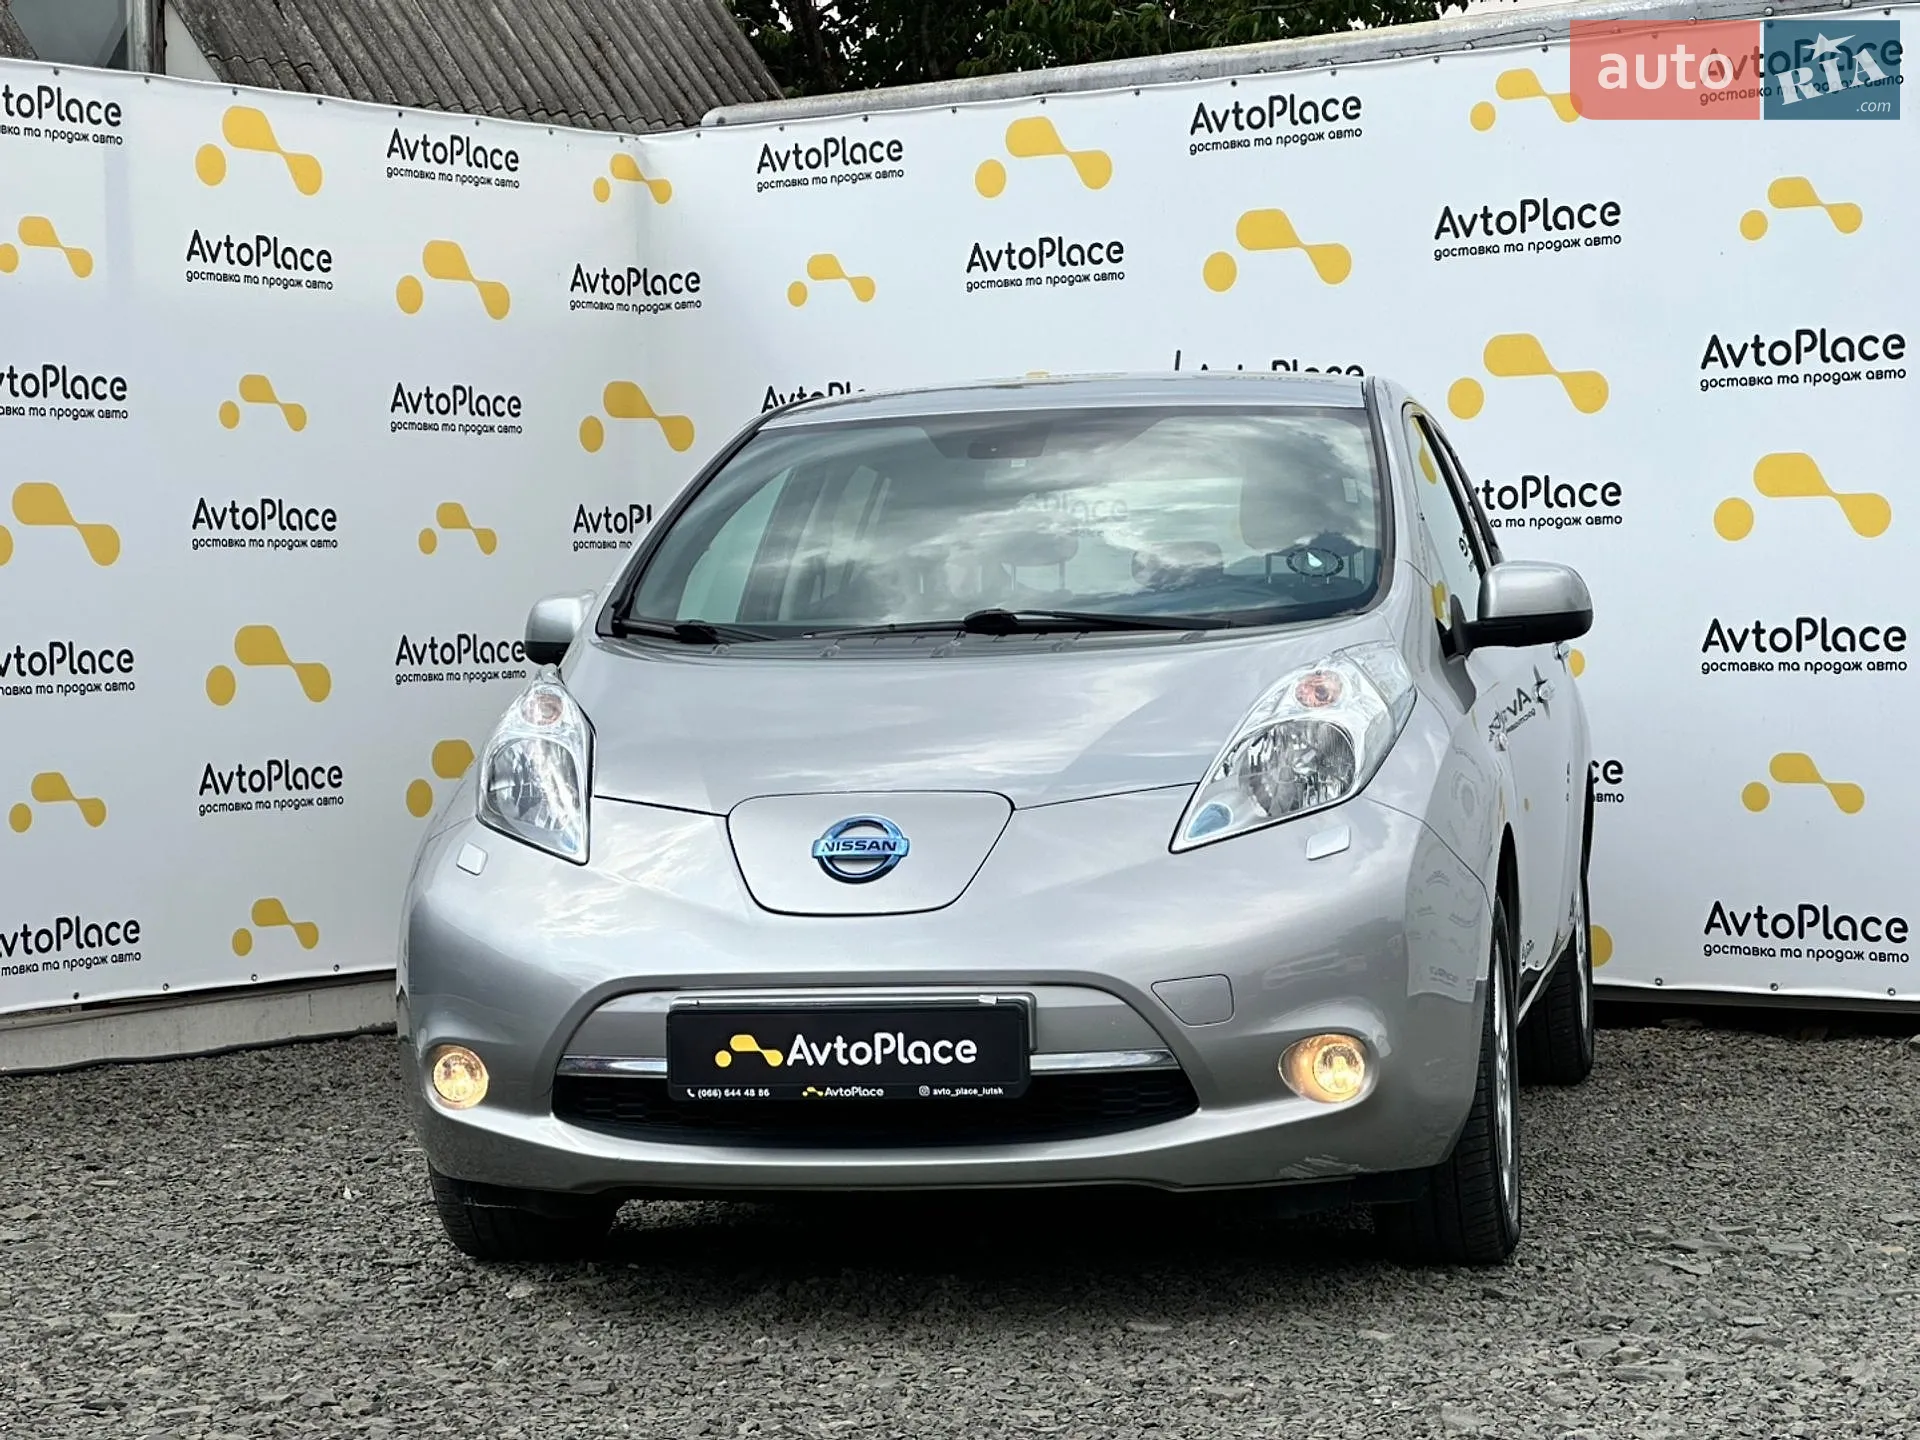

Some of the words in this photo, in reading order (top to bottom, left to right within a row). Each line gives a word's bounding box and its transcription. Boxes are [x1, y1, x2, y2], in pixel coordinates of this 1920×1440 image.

[1190, 93, 1362, 136] AvtoPlace
[387, 128, 519, 172] AvtoPlace
[757, 136, 903, 174] AvtoPlace
[1434, 197, 1621, 240] AvtoPlace
[186, 229, 332, 273] AvtoPlace
[966, 236, 1124, 274] AvtoPlace
[570, 263, 701, 297] AvtoPlace
[1700, 327, 1906, 370] AvtoPlace
[0, 364, 127, 402] toPlace
[390, 382, 522, 418] AvtoPlace
[1475, 475, 1622, 511] toPlace
[192, 497, 337, 532] AvtoPlace
[395, 633, 526, 667] AvtoPlace
[1701, 616, 1907, 653] AvtoPlace
[199, 759, 343, 796] AvtoPlace
[822, 840, 897, 852] NISSAN
[0, 915, 140, 957] vtoPlace
[1704, 900, 1909, 944] AvtoPlace
[786, 1032, 977, 1067] AvtoPlace
[824, 1086, 884, 1097] AvtoPlace
